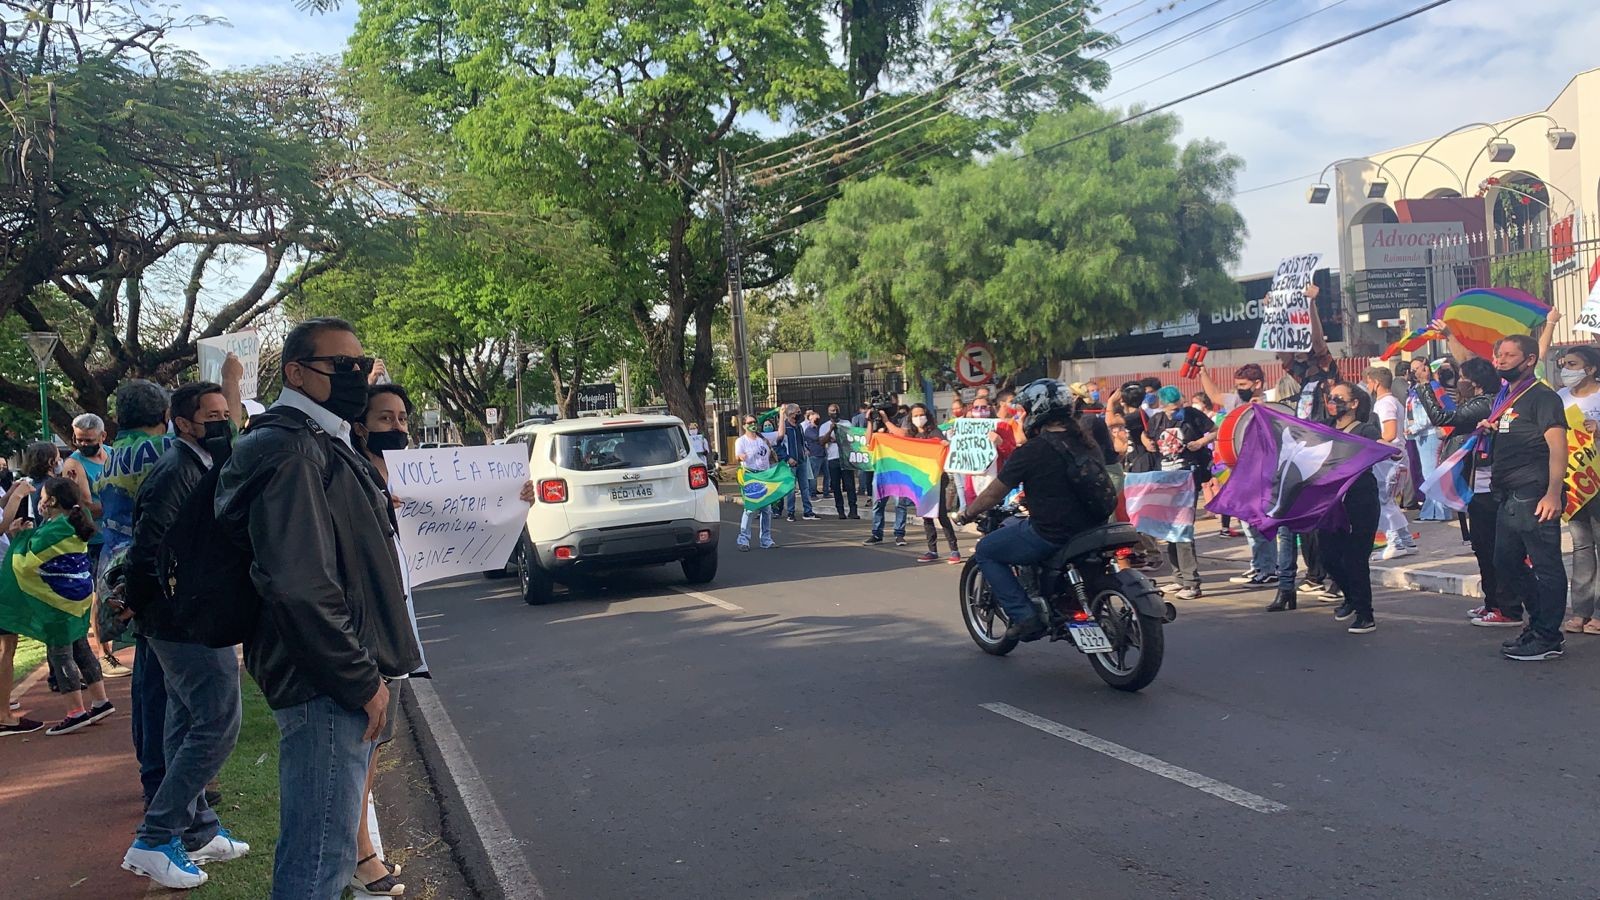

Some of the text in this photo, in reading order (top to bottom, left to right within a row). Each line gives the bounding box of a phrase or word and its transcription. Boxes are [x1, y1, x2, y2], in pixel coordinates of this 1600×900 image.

[1372, 227, 1461, 248] Advocacia
[1211, 300, 1266, 324] BURGE
[453, 451, 467, 481] É
[470, 461, 481, 481] A
[487, 461, 526, 480] FAVOR
[441, 494, 487, 515] PÁTRIA
